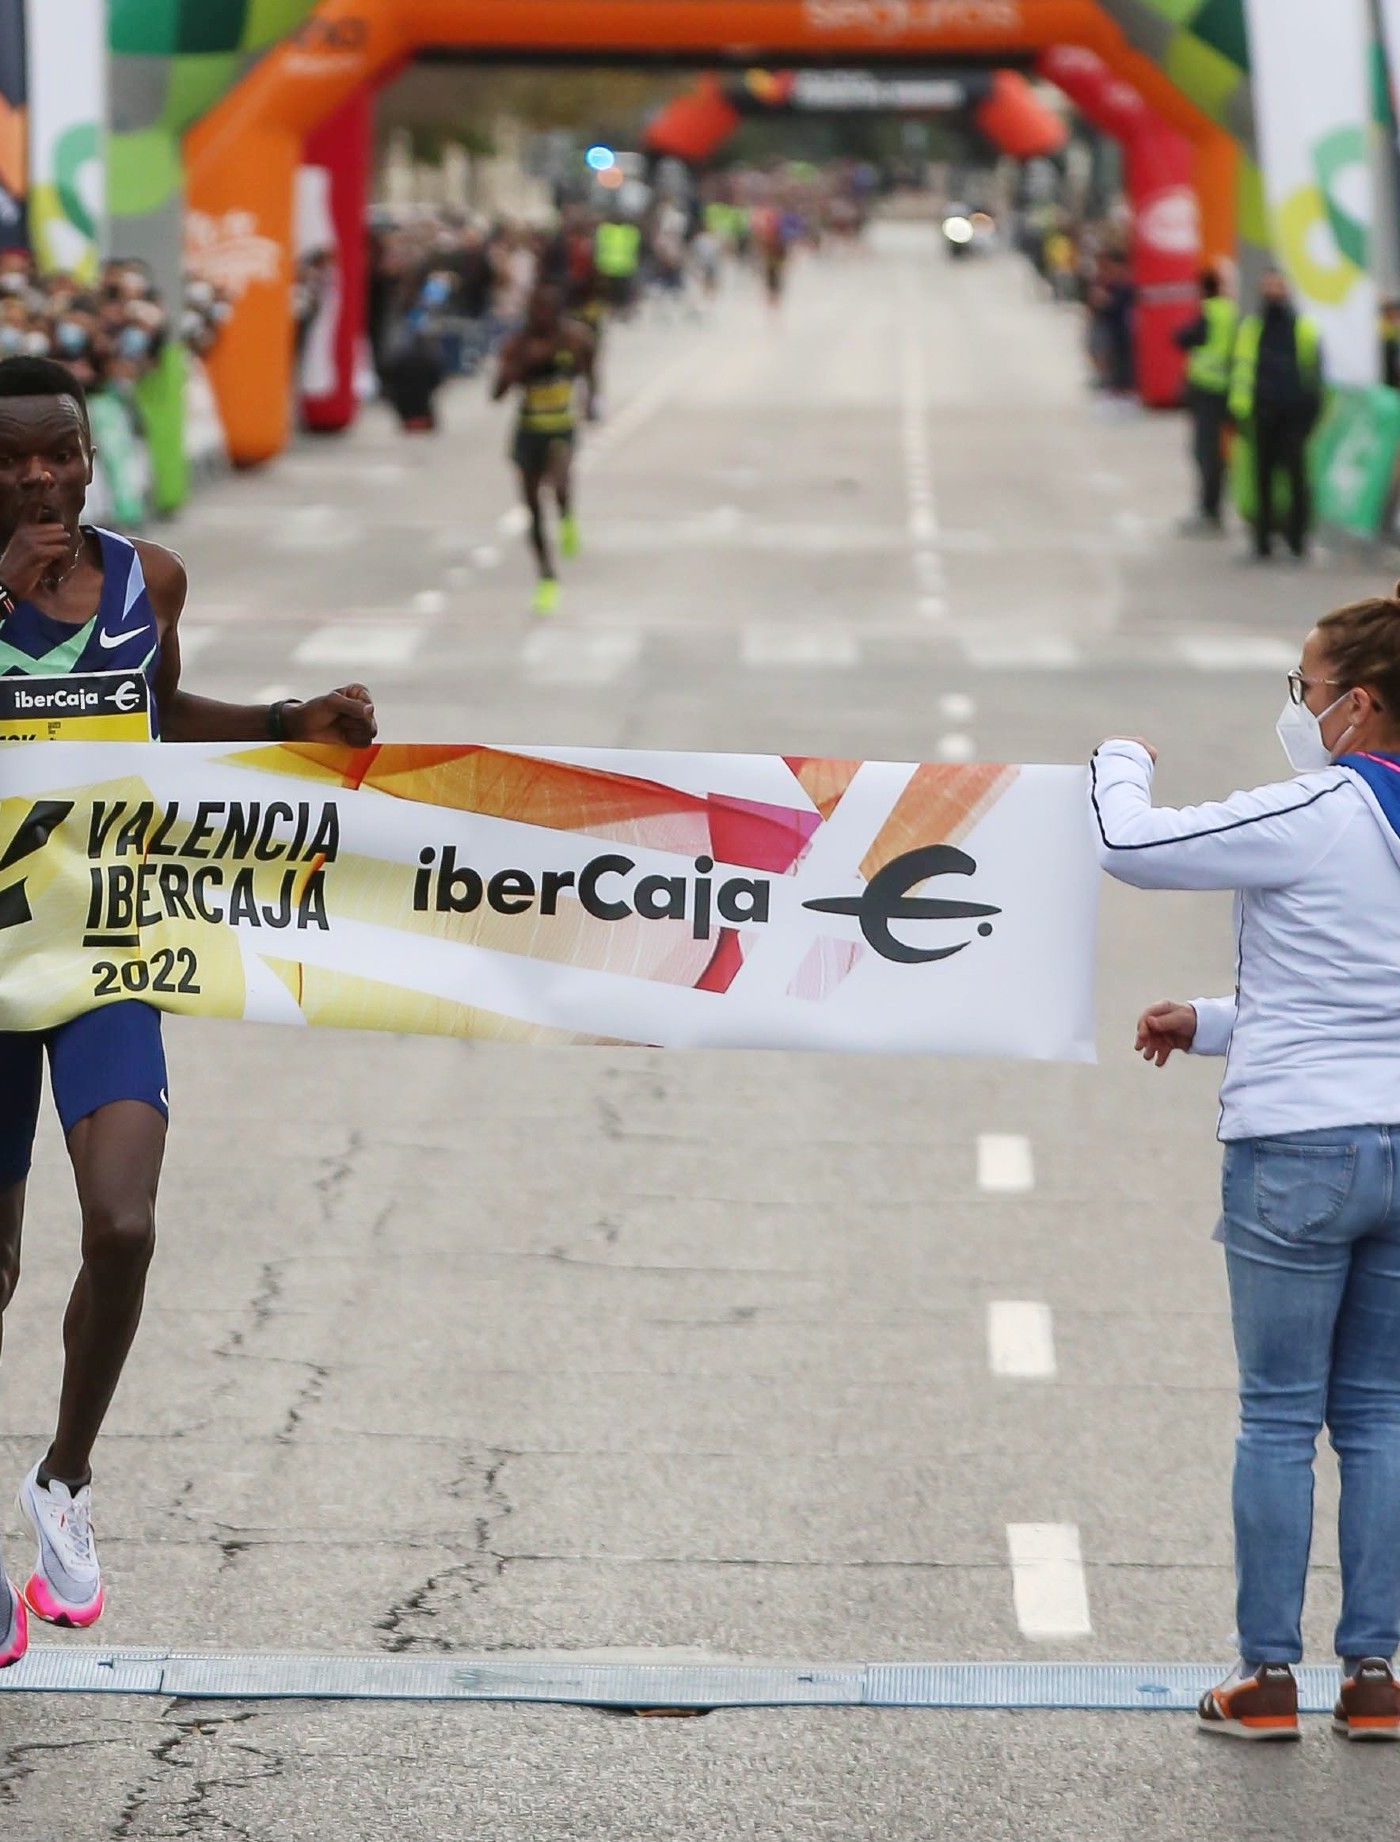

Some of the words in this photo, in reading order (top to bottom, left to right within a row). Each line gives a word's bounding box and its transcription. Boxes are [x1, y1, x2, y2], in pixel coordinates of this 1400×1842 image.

[14, 688, 99, 710] iberCaja
[87, 801, 340, 862] VALENCIA
[85, 853, 332, 931] IBERCAJA
[413, 845, 770, 940] iberCaja
[91, 947, 201, 997] 2022
